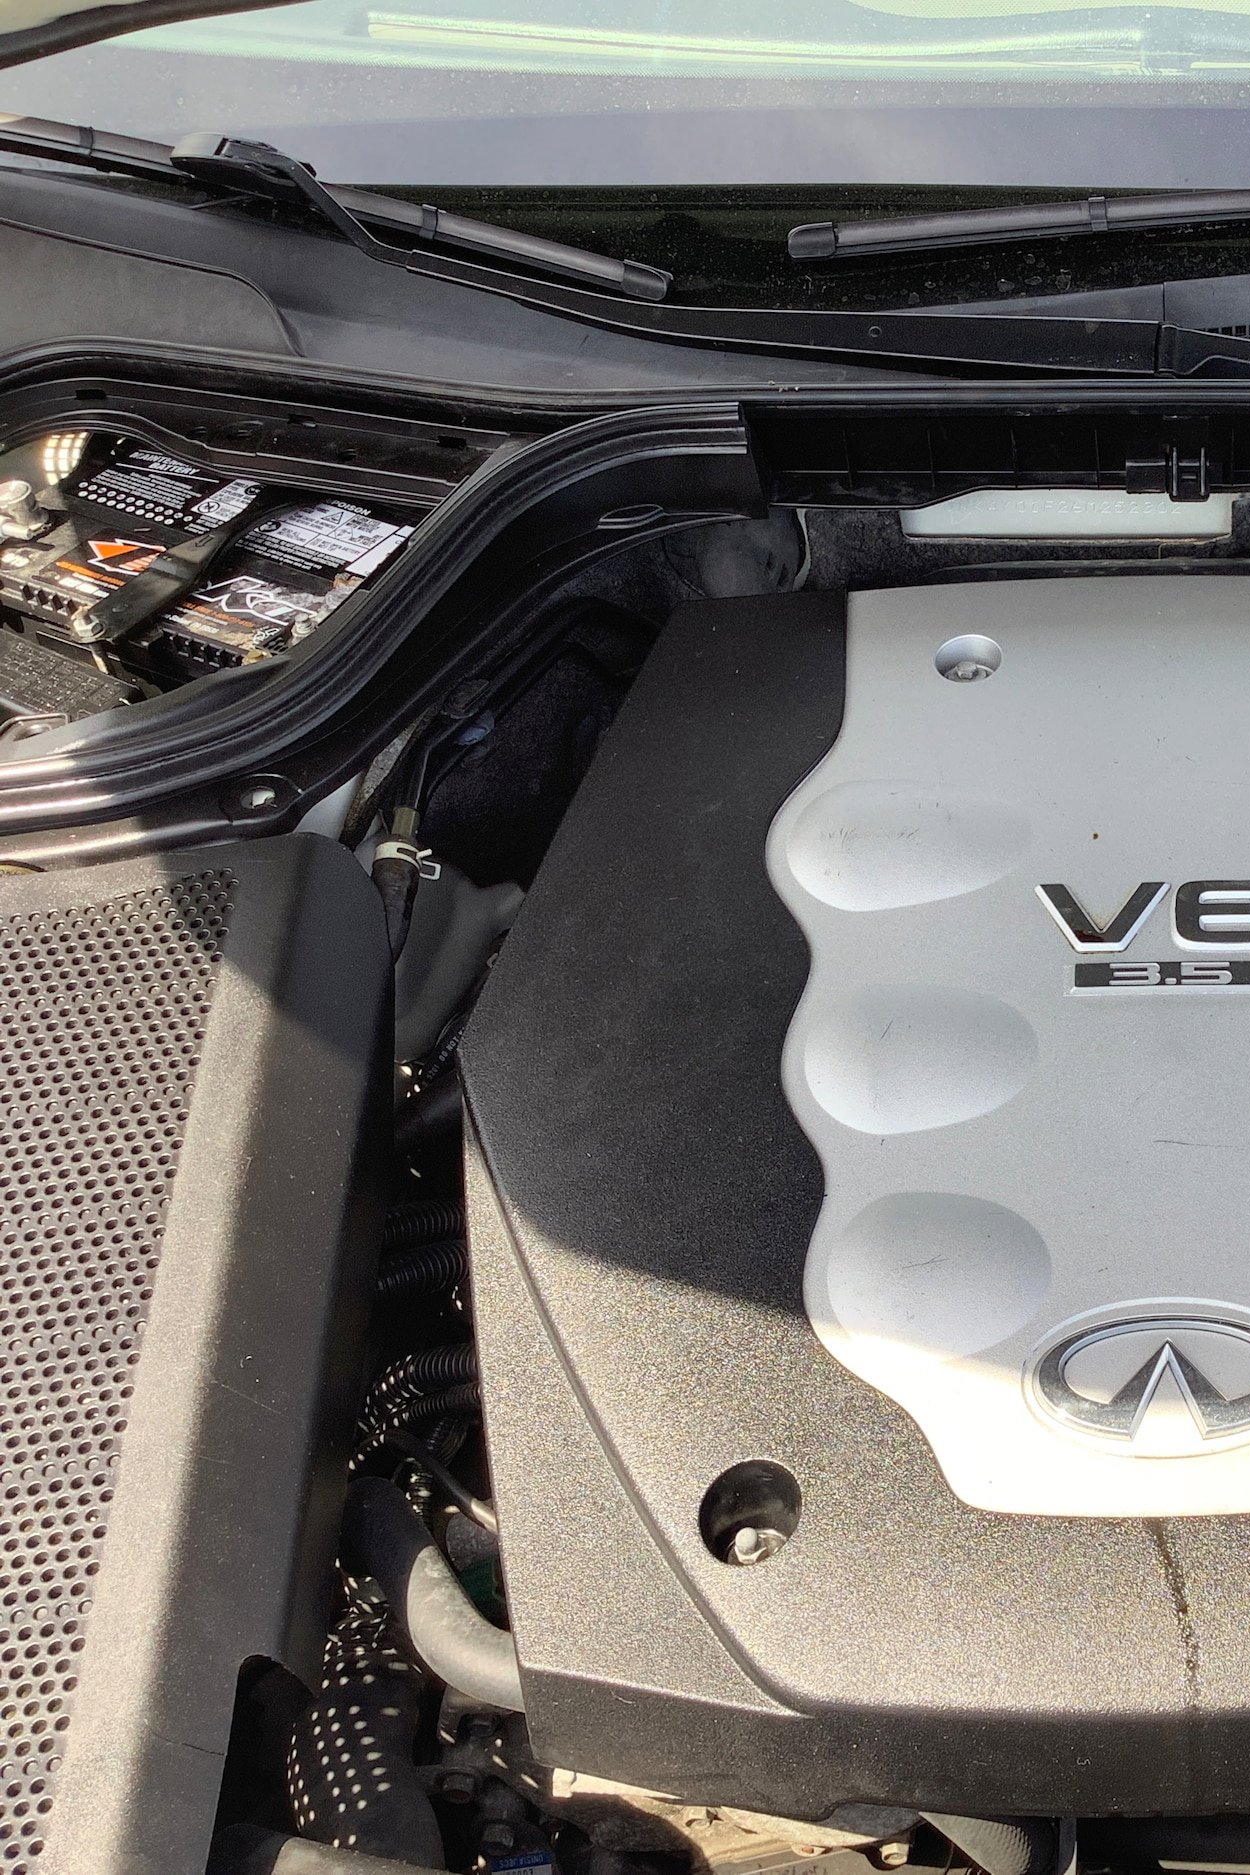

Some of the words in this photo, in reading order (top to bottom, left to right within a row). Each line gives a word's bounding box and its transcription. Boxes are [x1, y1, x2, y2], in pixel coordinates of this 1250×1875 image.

[148, 462, 200, 475] BATTERY
[331, 500, 371, 516] POISON
[1109, 961, 1233, 986] 3.5
